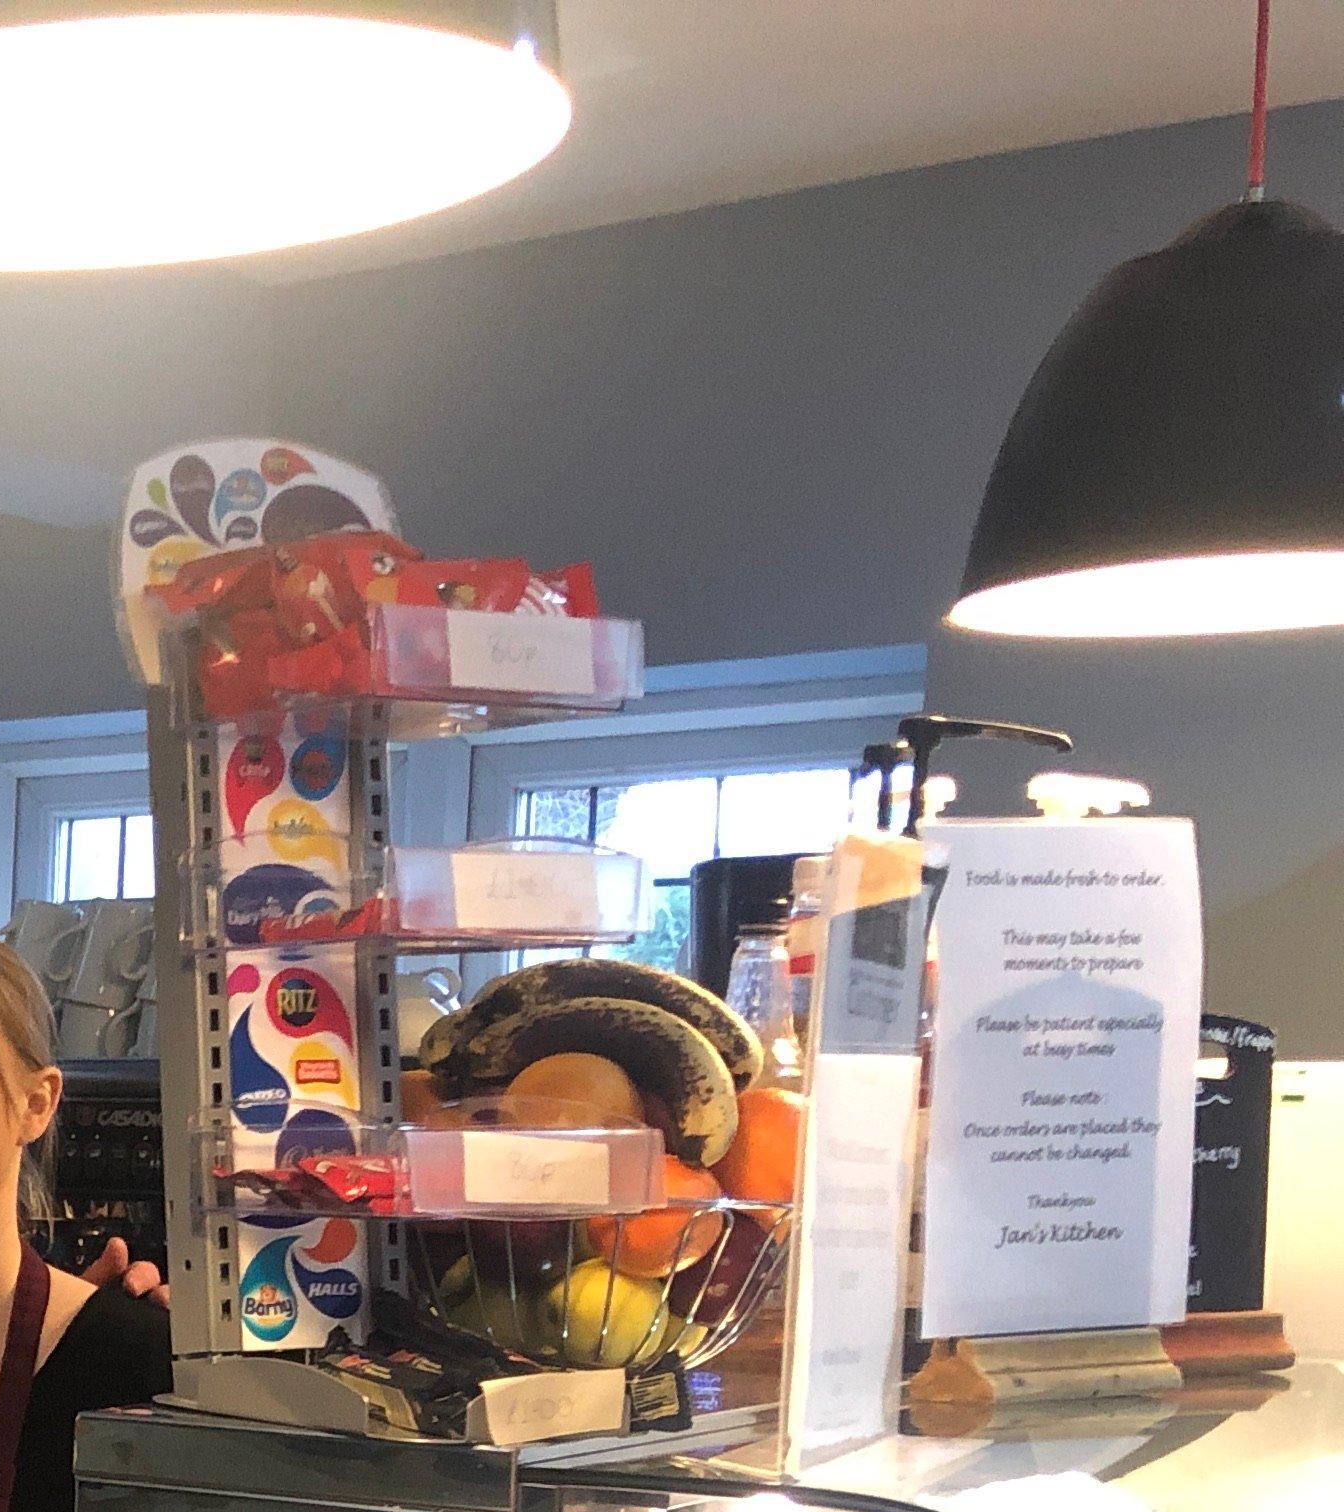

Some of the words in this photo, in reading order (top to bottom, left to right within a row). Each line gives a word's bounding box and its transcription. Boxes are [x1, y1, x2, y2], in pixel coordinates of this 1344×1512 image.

[966, 869, 1002, 887] Food
[1021, 868, 1063, 887] made
[1102, 870, 1121, 886] to
[1003, 927, 1034, 946] This
[1035, 933, 1068, 949] may
[1070, 927, 1103, 946] take
[1118, 928, 1144, 948] few
[1003, 955, 1070, 971] moments
[1070, 957, 1087, 971] to
[1087, 957, 1144, 976] prepare
[275, 987, 317, 1017] RITZ
[976, 1015, 1021, 1034] Please
[1023, 1015, 1040, 1032] be
[1042, 1015, 1095, 1035] patient
[1096, 1012, 1164, 1035] especially
[1022, 1040, 1040, 1058] at
[1042, 1040, 1074, 1060] busy
[1076, 1042, 1116, 1057] times
[1021, 1089, 1066, 1108] Please
[963, 1121, 1001, 1139] Once
[1002, 1119, 1050, 1139] orders
[1053, 1123, 1079, 1137] are
[1078, 1118, 1130, 1140] placed
[991, 1146, 1043, 1163] cannot
[1046, 1143, 1065, 1161] be
[1066, 1141, 1131, 1165] changed
[995, 1222, 1051, 1250] Jan's
[1051, 1220, 1125, 1244] Kitchen
[308, 1281, 359, 1298] HALLS
[243, 1297, 293, 1318] Barny
